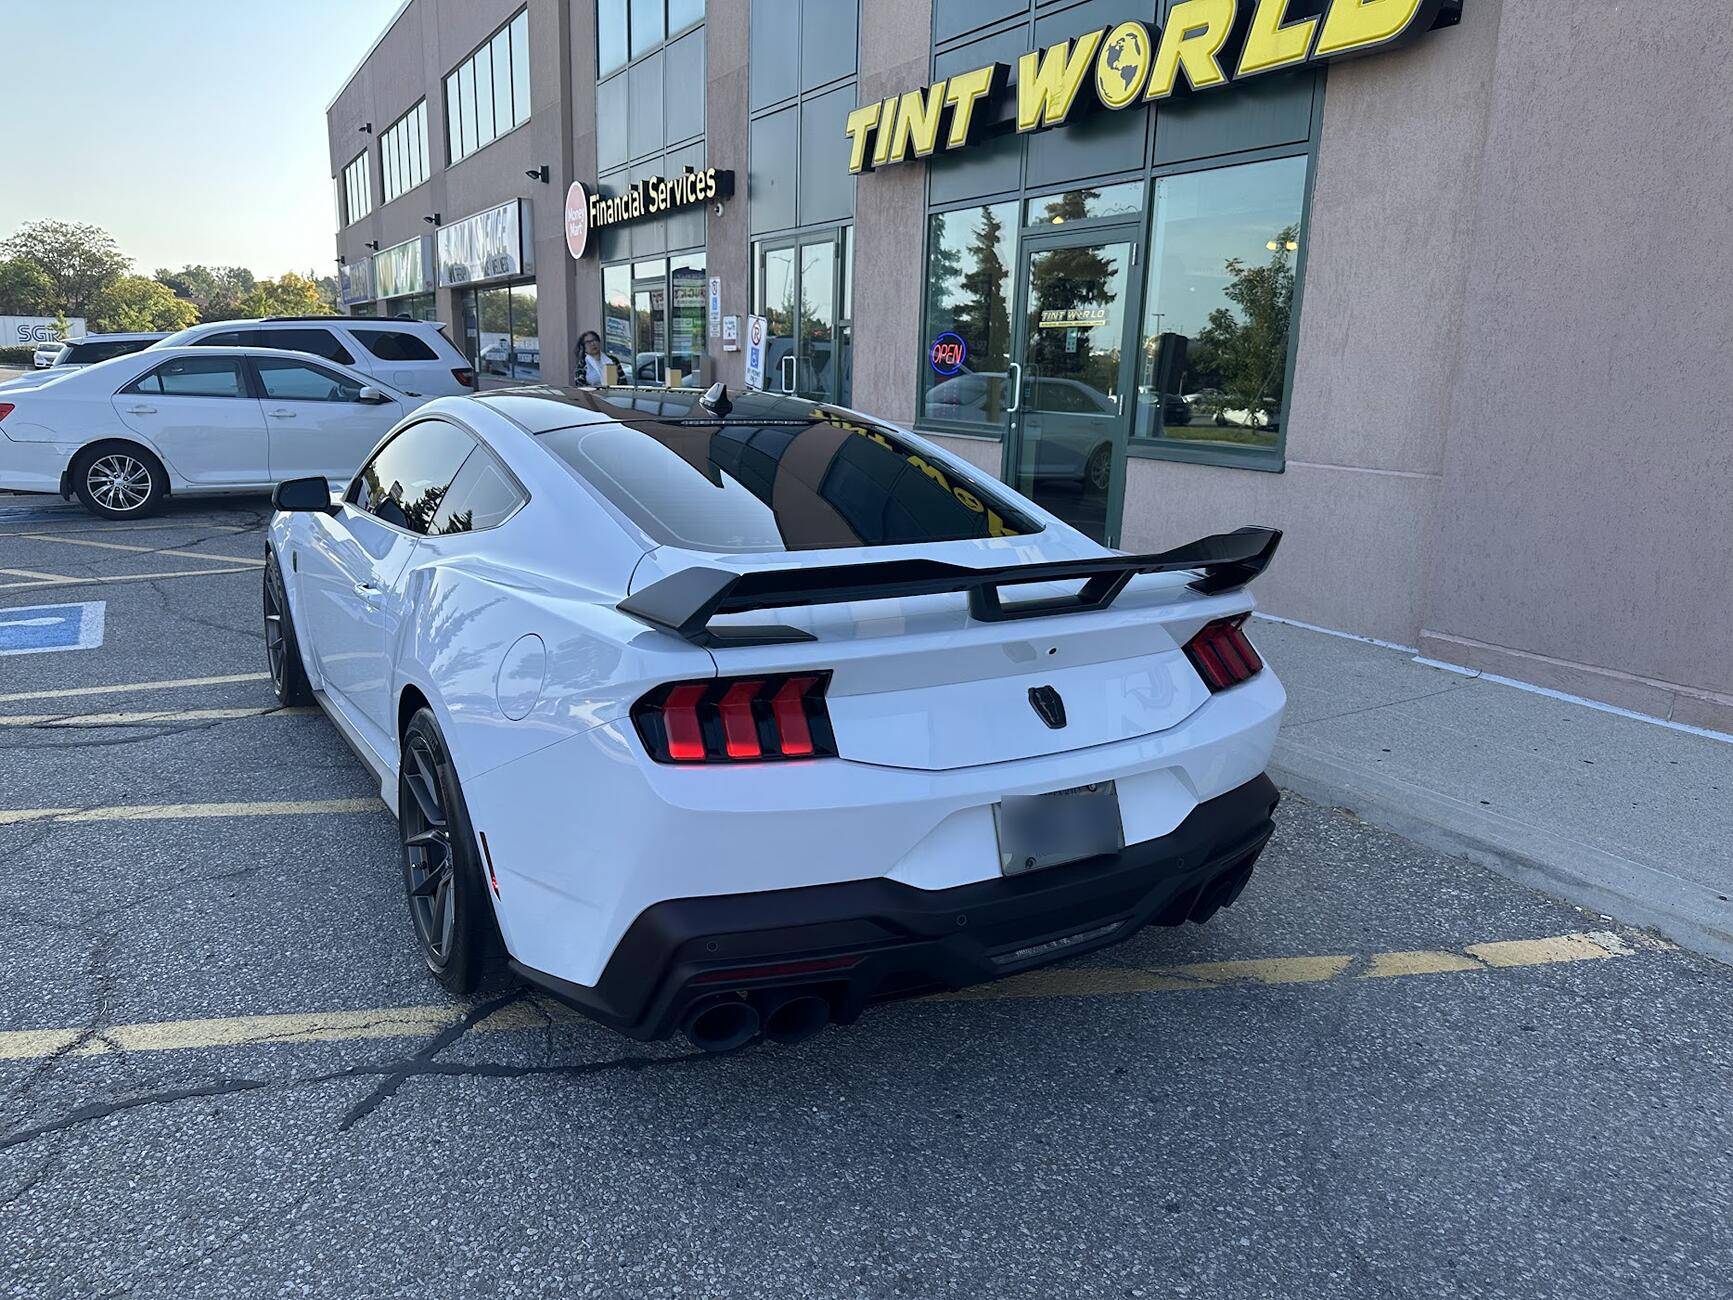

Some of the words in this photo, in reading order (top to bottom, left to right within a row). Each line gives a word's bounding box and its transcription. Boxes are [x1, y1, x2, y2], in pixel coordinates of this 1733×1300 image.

[846, 65, 995, 174] TINT
[589, 180, 645, 228] Financial
[648, 166, 716, 214] Services
[567, 207, 585, 222] Money
[1041, 310, 1066, 321] TINT
[932, 344, 962, 364] OPEN
